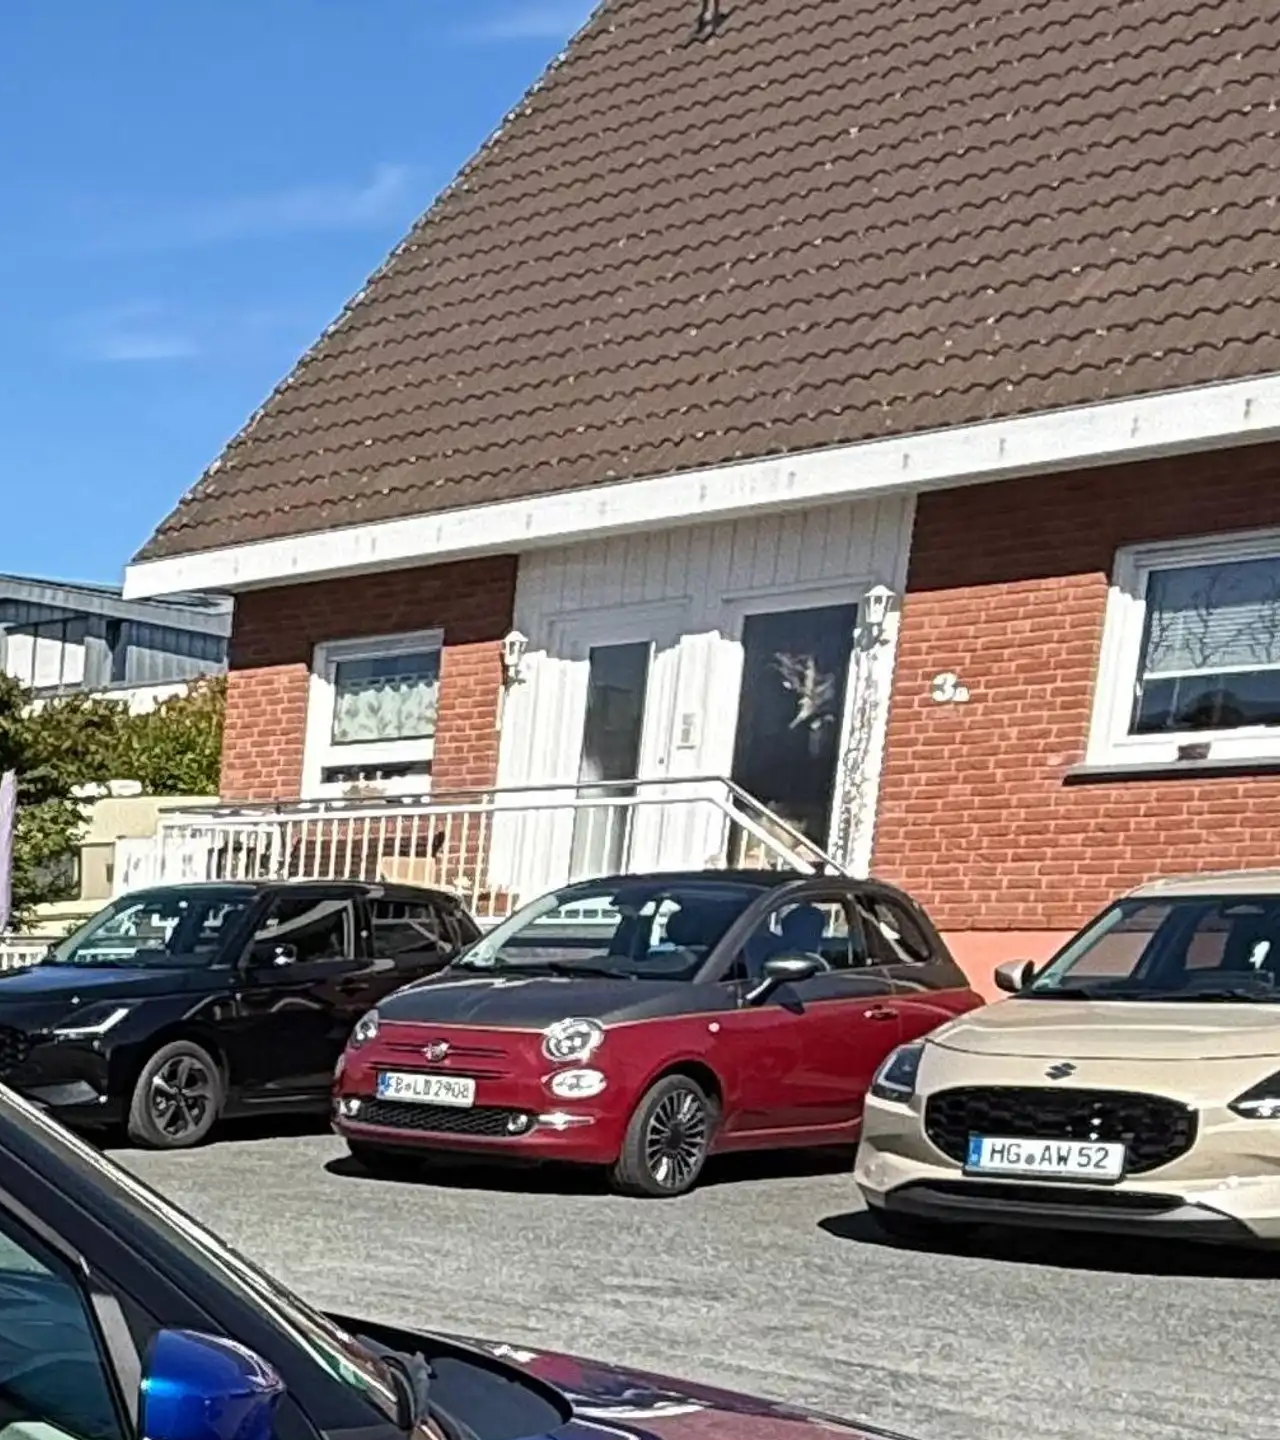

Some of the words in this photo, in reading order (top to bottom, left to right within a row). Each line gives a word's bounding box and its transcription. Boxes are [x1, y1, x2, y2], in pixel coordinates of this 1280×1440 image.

[990, 1142, 1022, 1165] HG
[1038, 1144, 1072, 1167] AW
[1076, 1146, 1110, 1169] 52
